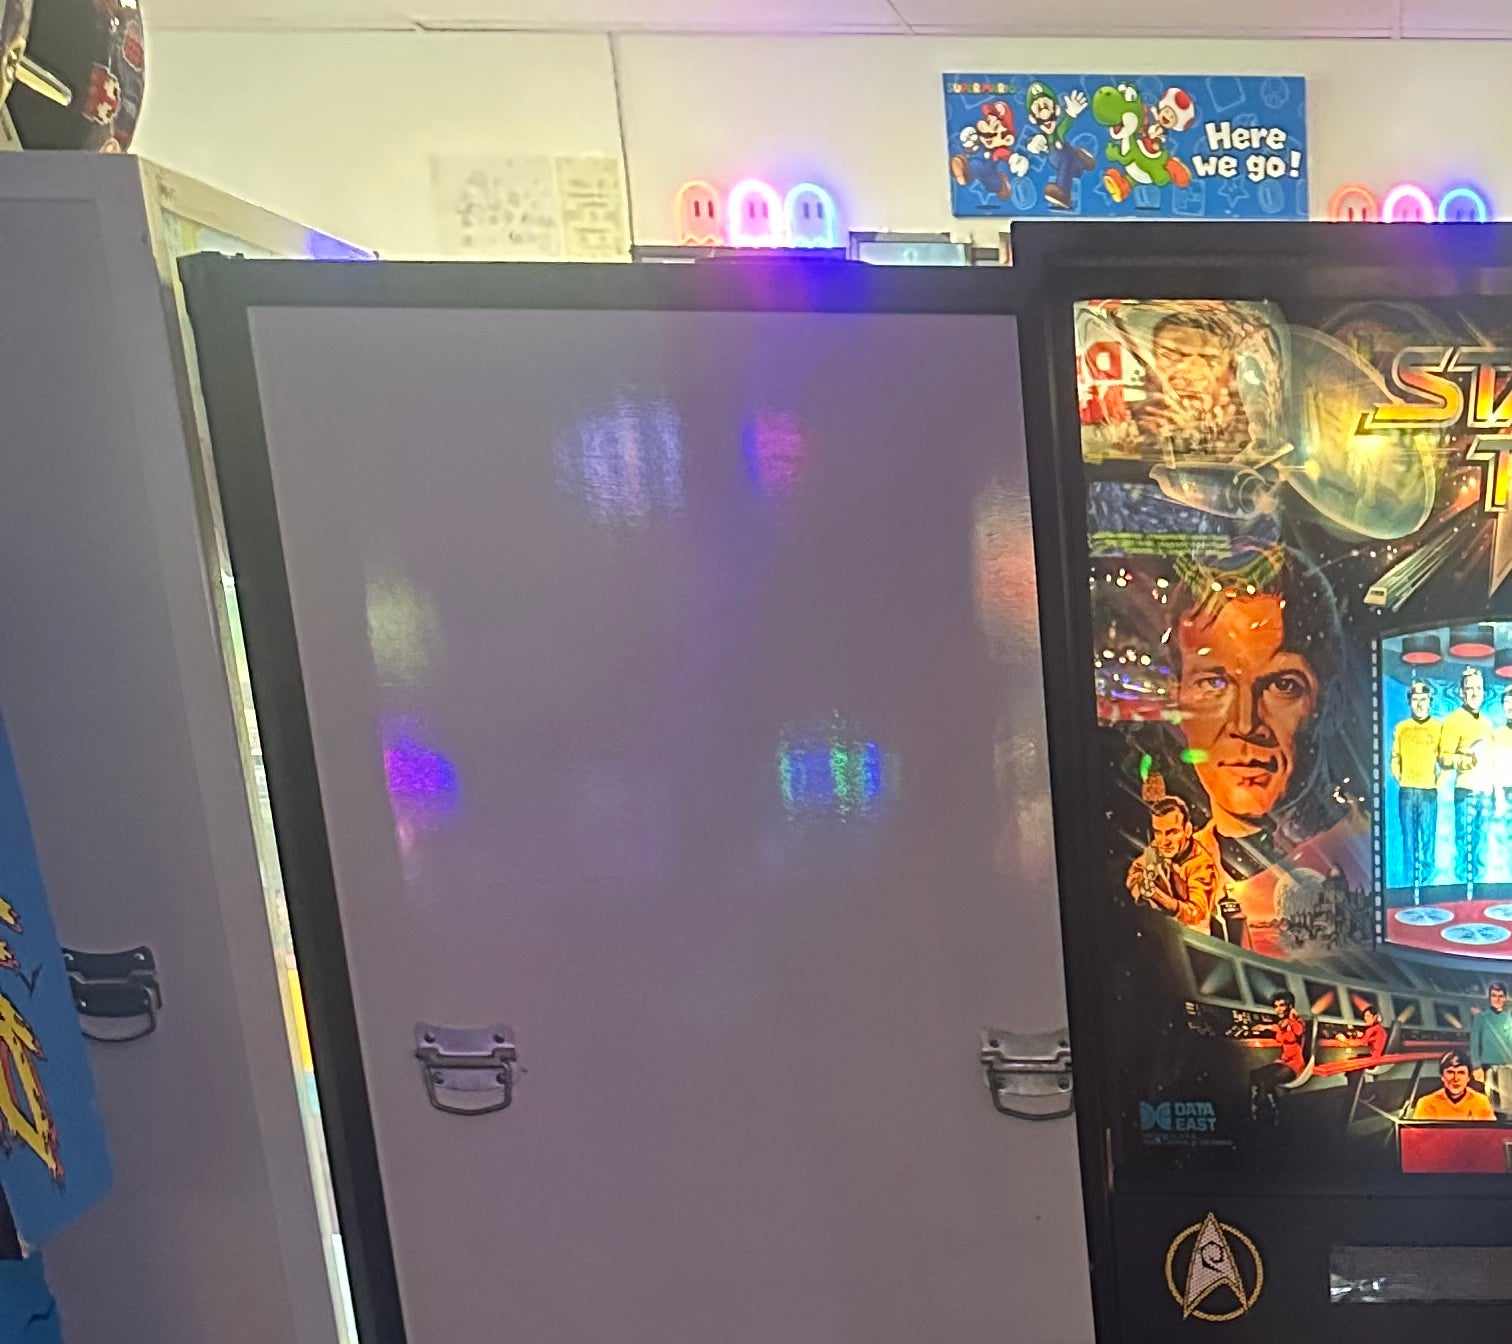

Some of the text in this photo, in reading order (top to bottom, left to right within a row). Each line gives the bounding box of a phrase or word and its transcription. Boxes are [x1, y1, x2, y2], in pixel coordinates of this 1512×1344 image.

[1205, 122, 1287, 151] Here
[1192, 151, 1302, 182] we go!
[1174, 1101, 1215, 1116] DATA
[1175, 1117, 1217, 1132] EAST
